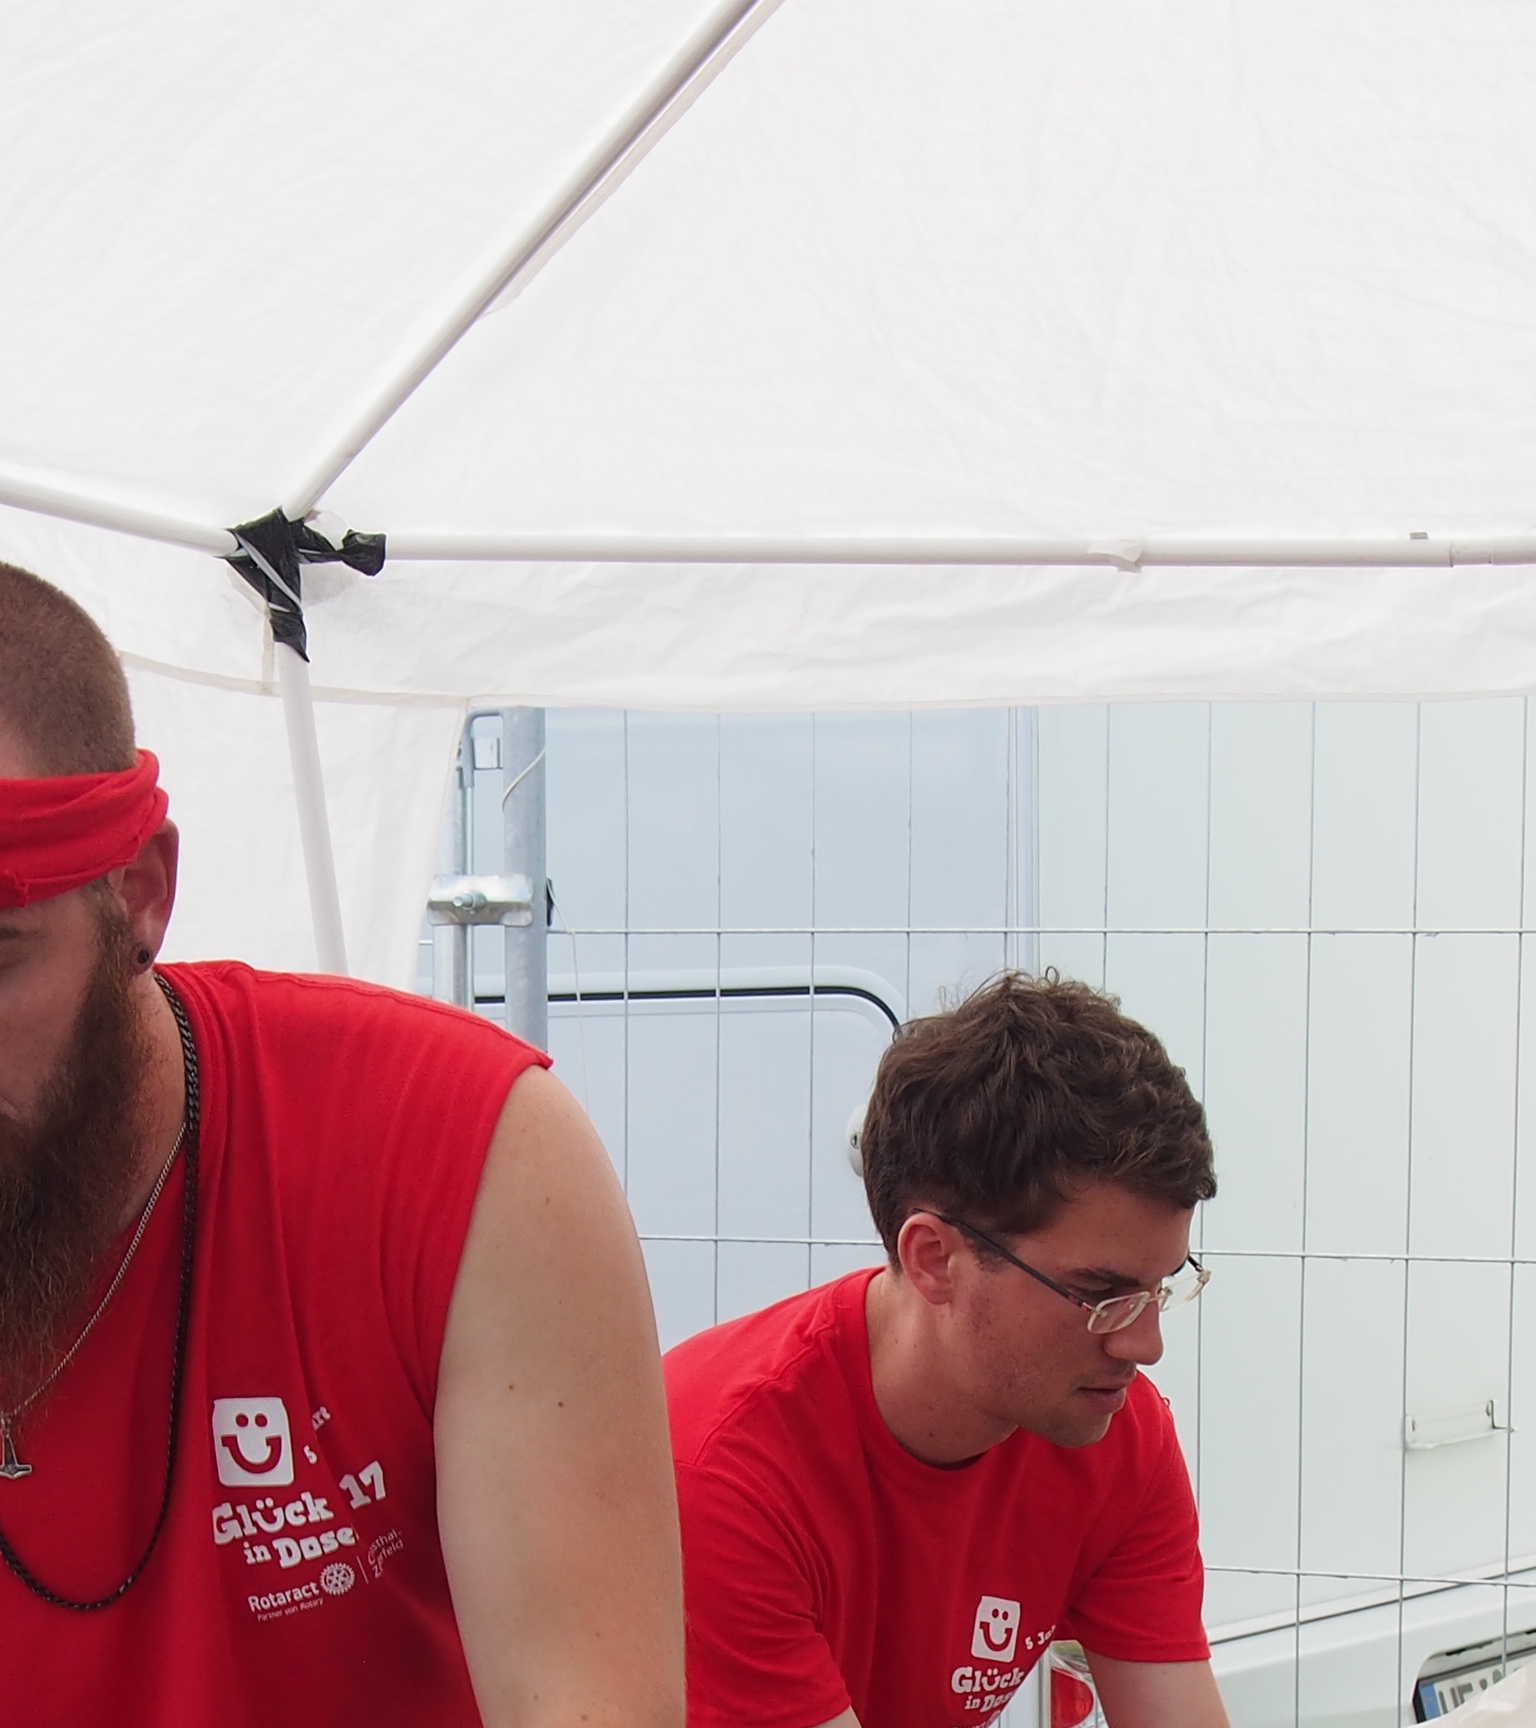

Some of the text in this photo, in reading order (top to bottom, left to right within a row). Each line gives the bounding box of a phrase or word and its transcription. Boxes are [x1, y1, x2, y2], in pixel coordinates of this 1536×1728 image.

[212, 1491, 334, 1545] Glück
[242, 1525, 360, 1569] in Dase
[247, 1581, 320, 1613] Rotaract
[1024, 1637, 1034, 1650] 5
[951, 1666, 1025, 1694] Glück
[964, 1695, 980, 1710] in
